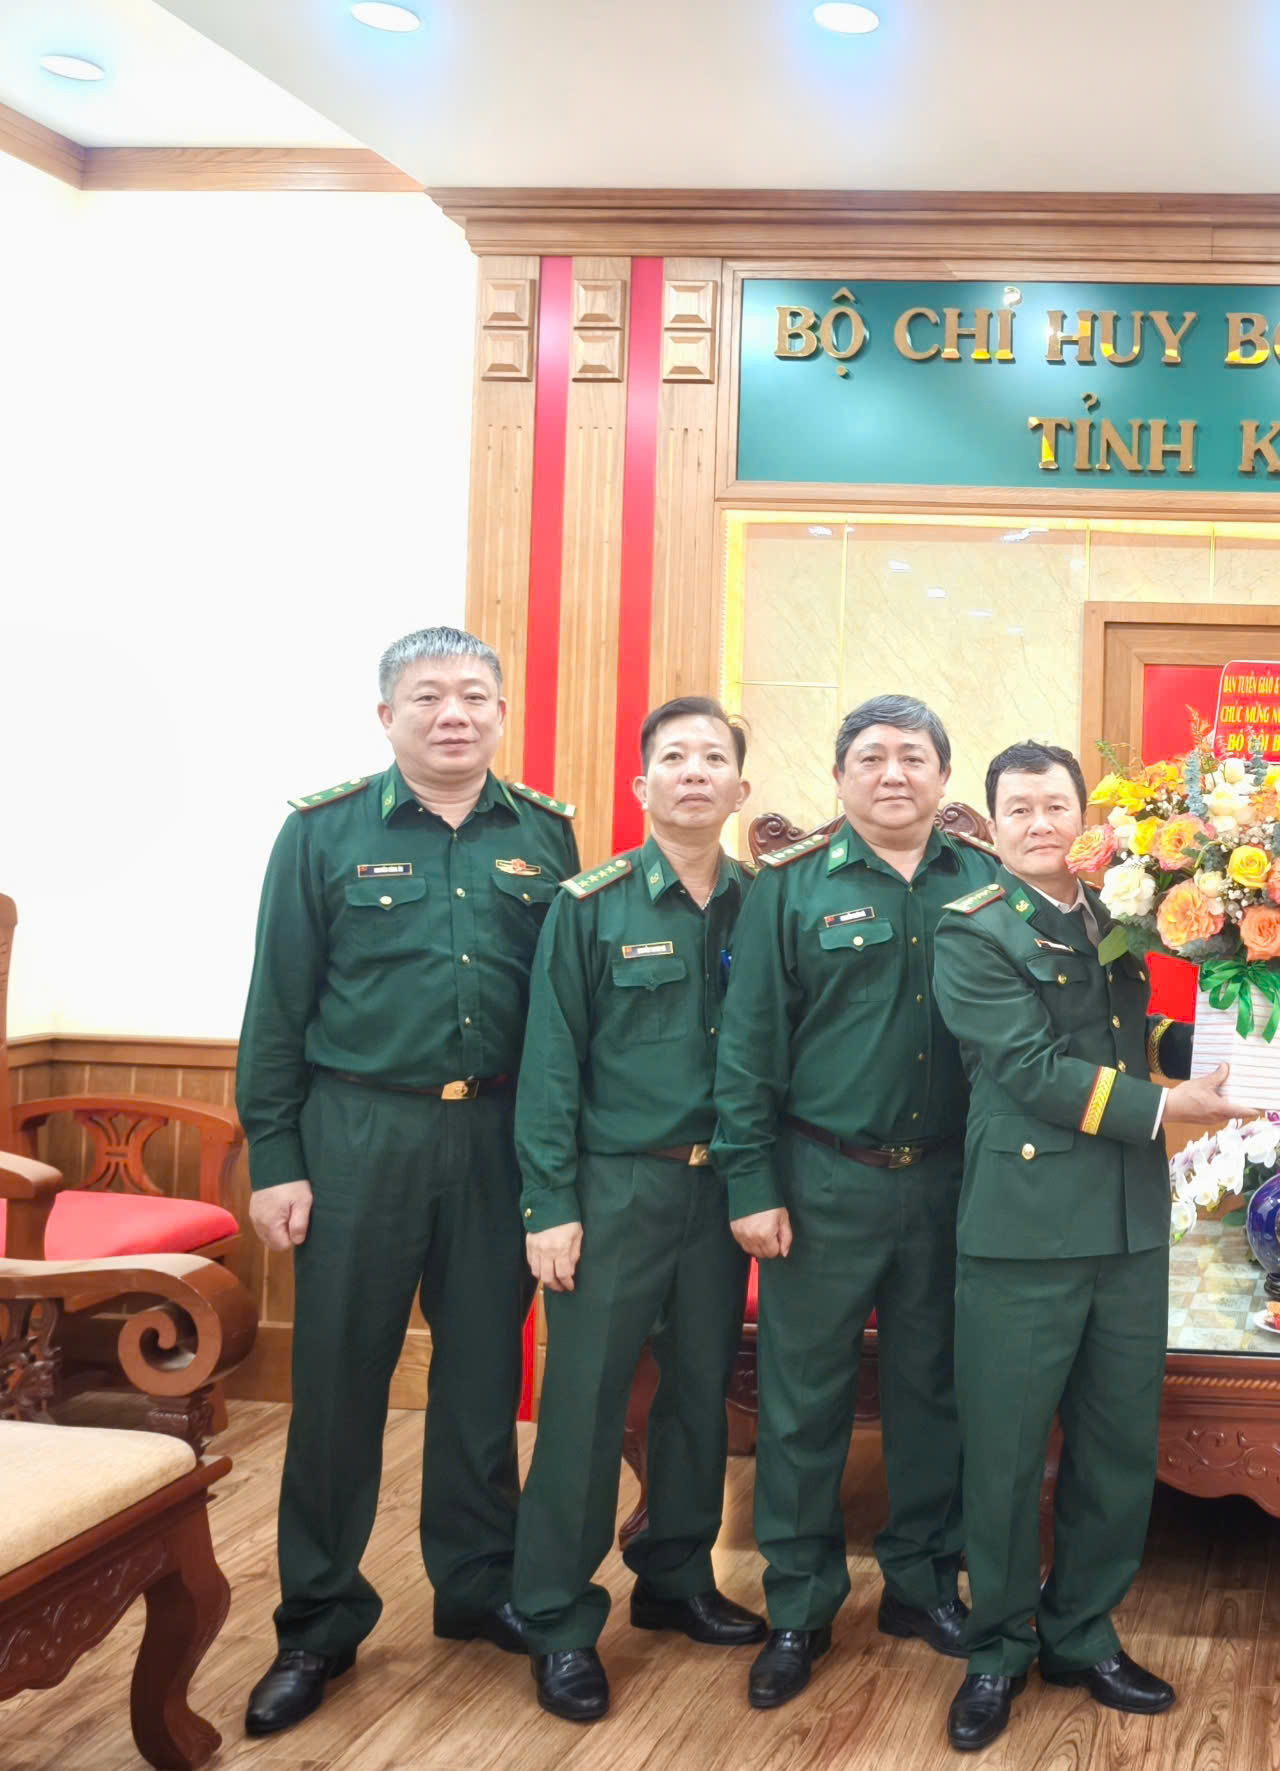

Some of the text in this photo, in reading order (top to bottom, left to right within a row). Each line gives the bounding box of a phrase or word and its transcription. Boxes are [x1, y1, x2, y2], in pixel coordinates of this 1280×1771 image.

[775, 287, 867, 377] BỘ
[894, 287, 1022, 361] CHỈ
[1045, 310, 1196, 364] HUY
[1028, 393, 1197, 472] TỈNH
[1220, 700, 1242, 723] CHÚC
[1245, 701, 1270, 724] MỪNG
